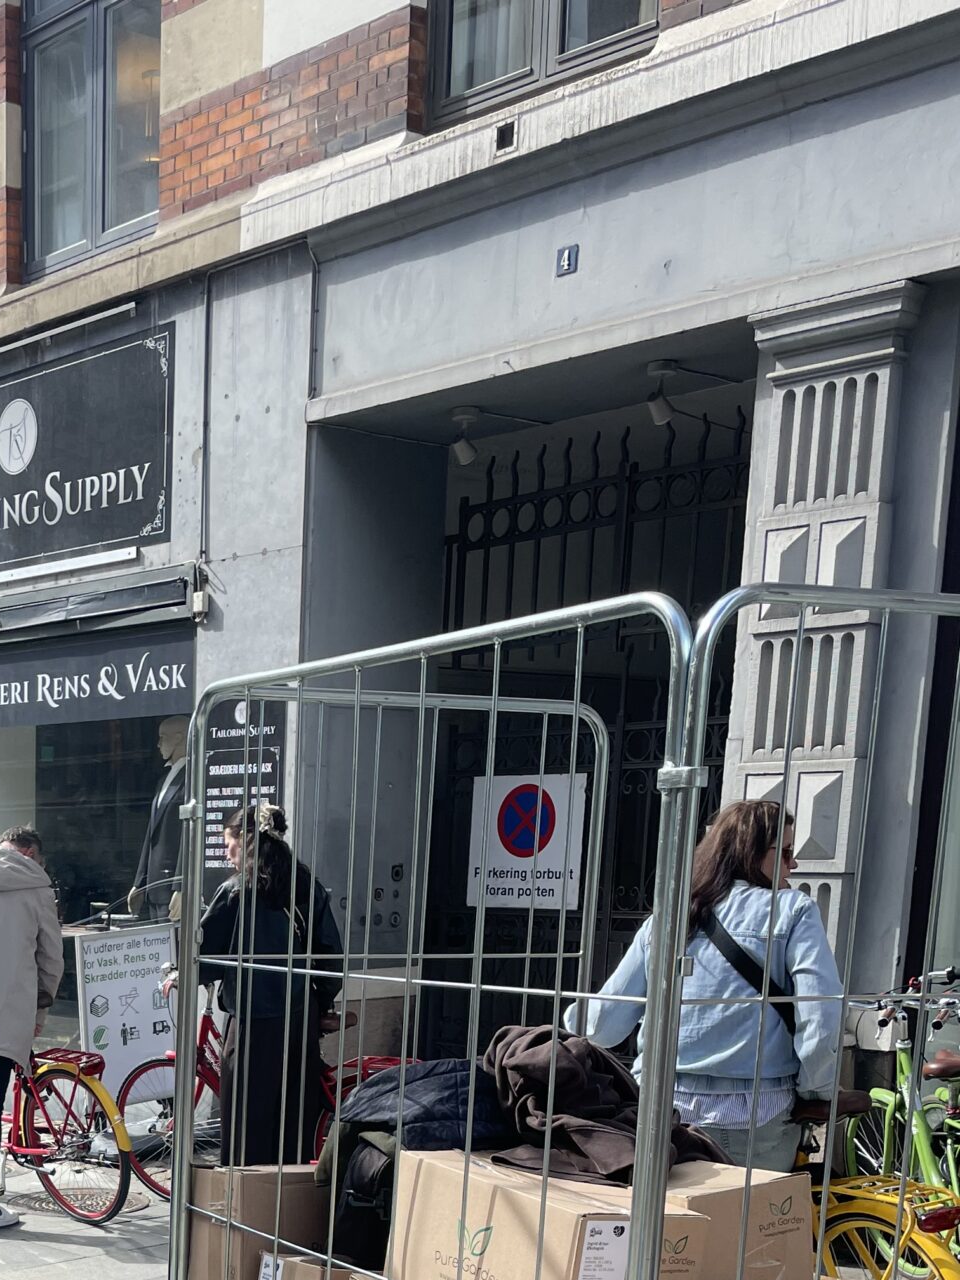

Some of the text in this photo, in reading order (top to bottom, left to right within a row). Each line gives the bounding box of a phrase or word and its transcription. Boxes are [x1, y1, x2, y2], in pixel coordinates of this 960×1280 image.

[560, 249, 571, 271] 4
[37, 673, 90, 708] RENS
[97, 663, 126, 700] &
[125, 651, 187, 693] VASK
[474, 866, 527, 881] Prkering
[485, 883, 514, 897] foran
[83, 935, 170, 955] Vi udfører alle former
[83, 959, 95, 970] for
[123, 953, 146, 965] Rens
[148, 952, 160, 963] og
[84, 969, 128, 984] Skrædder
[434, 1250, 459, 1268] Pure
[668, 1256, 696, 1267] Garden
